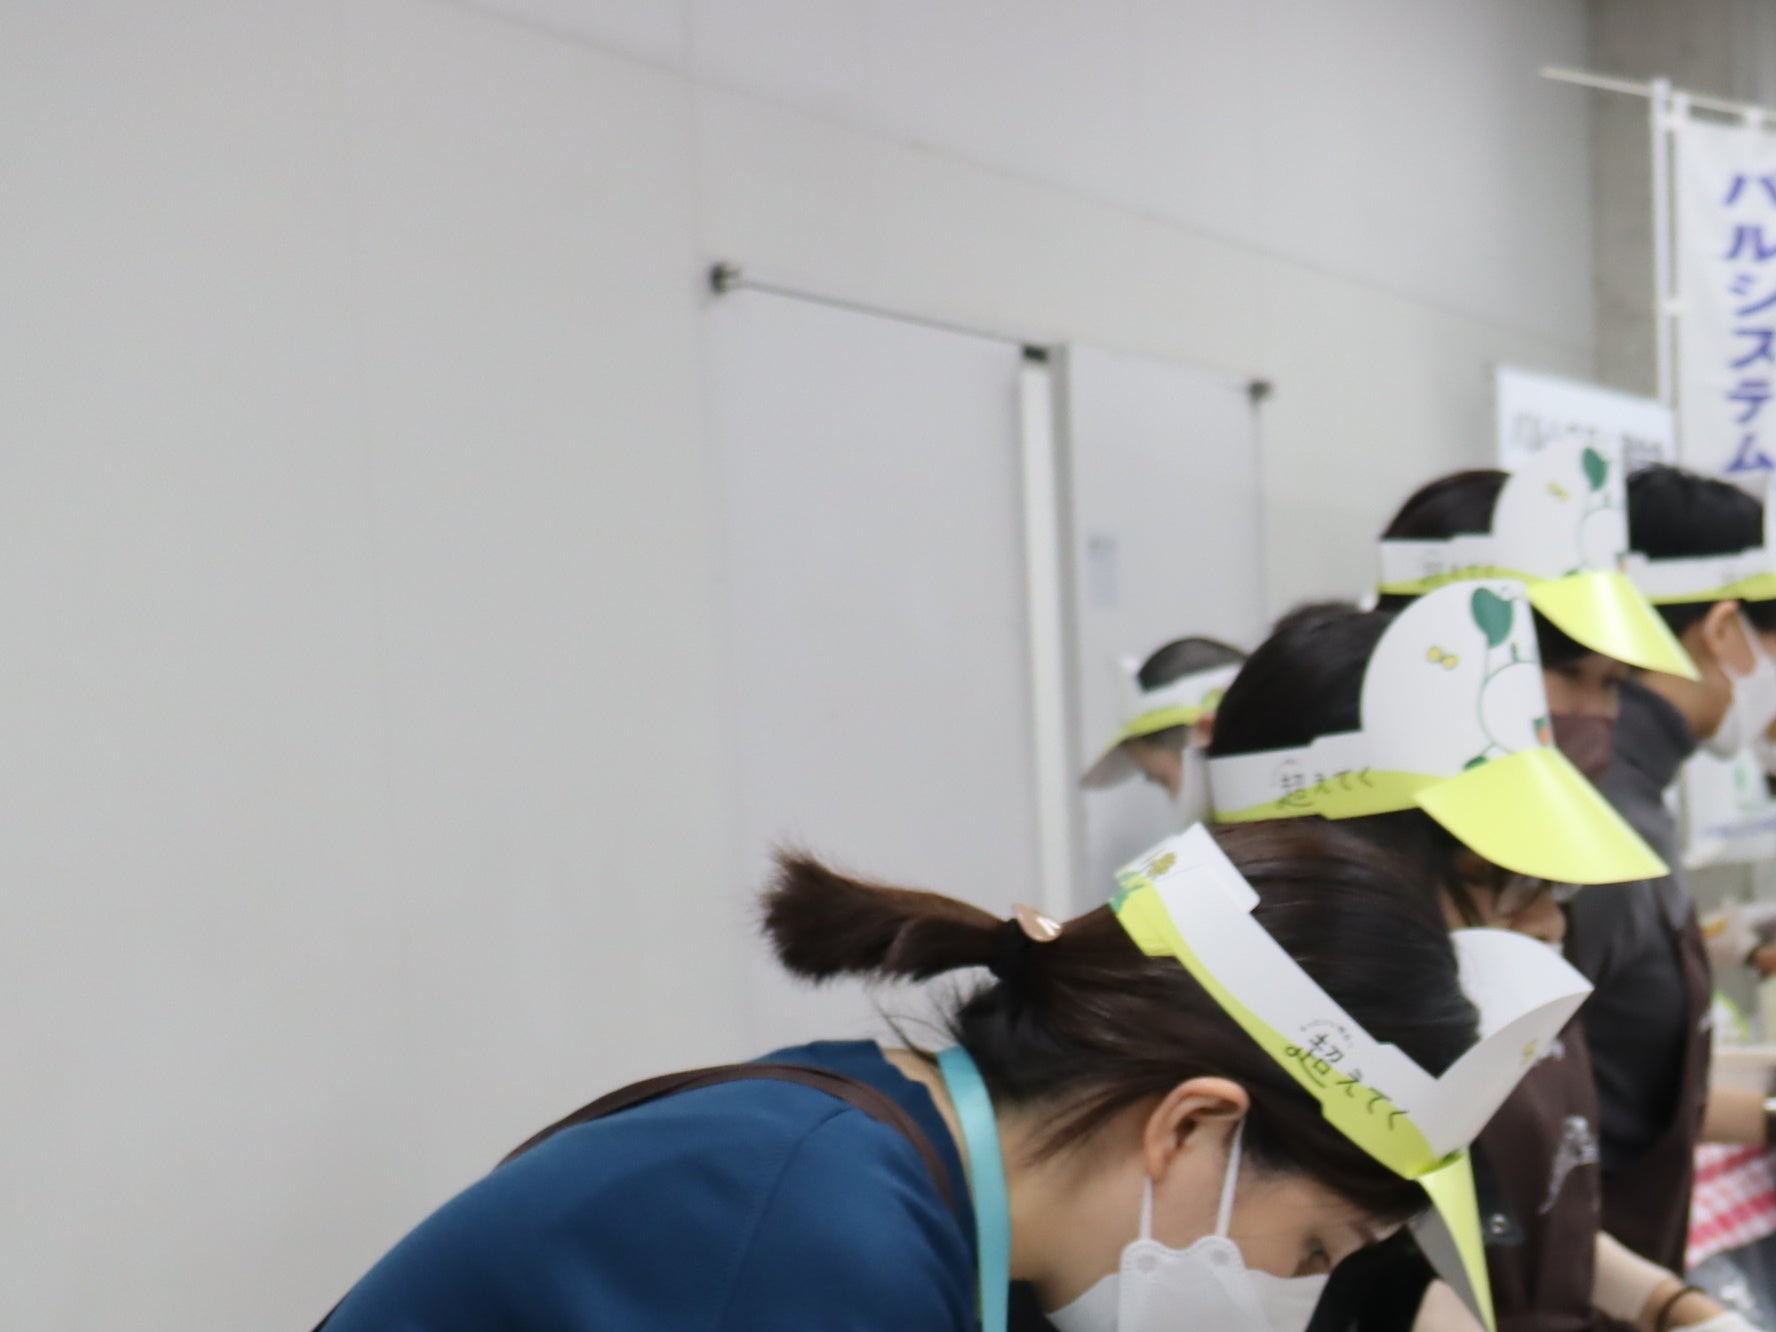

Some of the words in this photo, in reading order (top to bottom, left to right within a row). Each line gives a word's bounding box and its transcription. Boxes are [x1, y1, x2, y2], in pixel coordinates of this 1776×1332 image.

[1275, 767, 1375, 810] 超えてく
[1284, 1033, 1409, 1131] 超えてく
